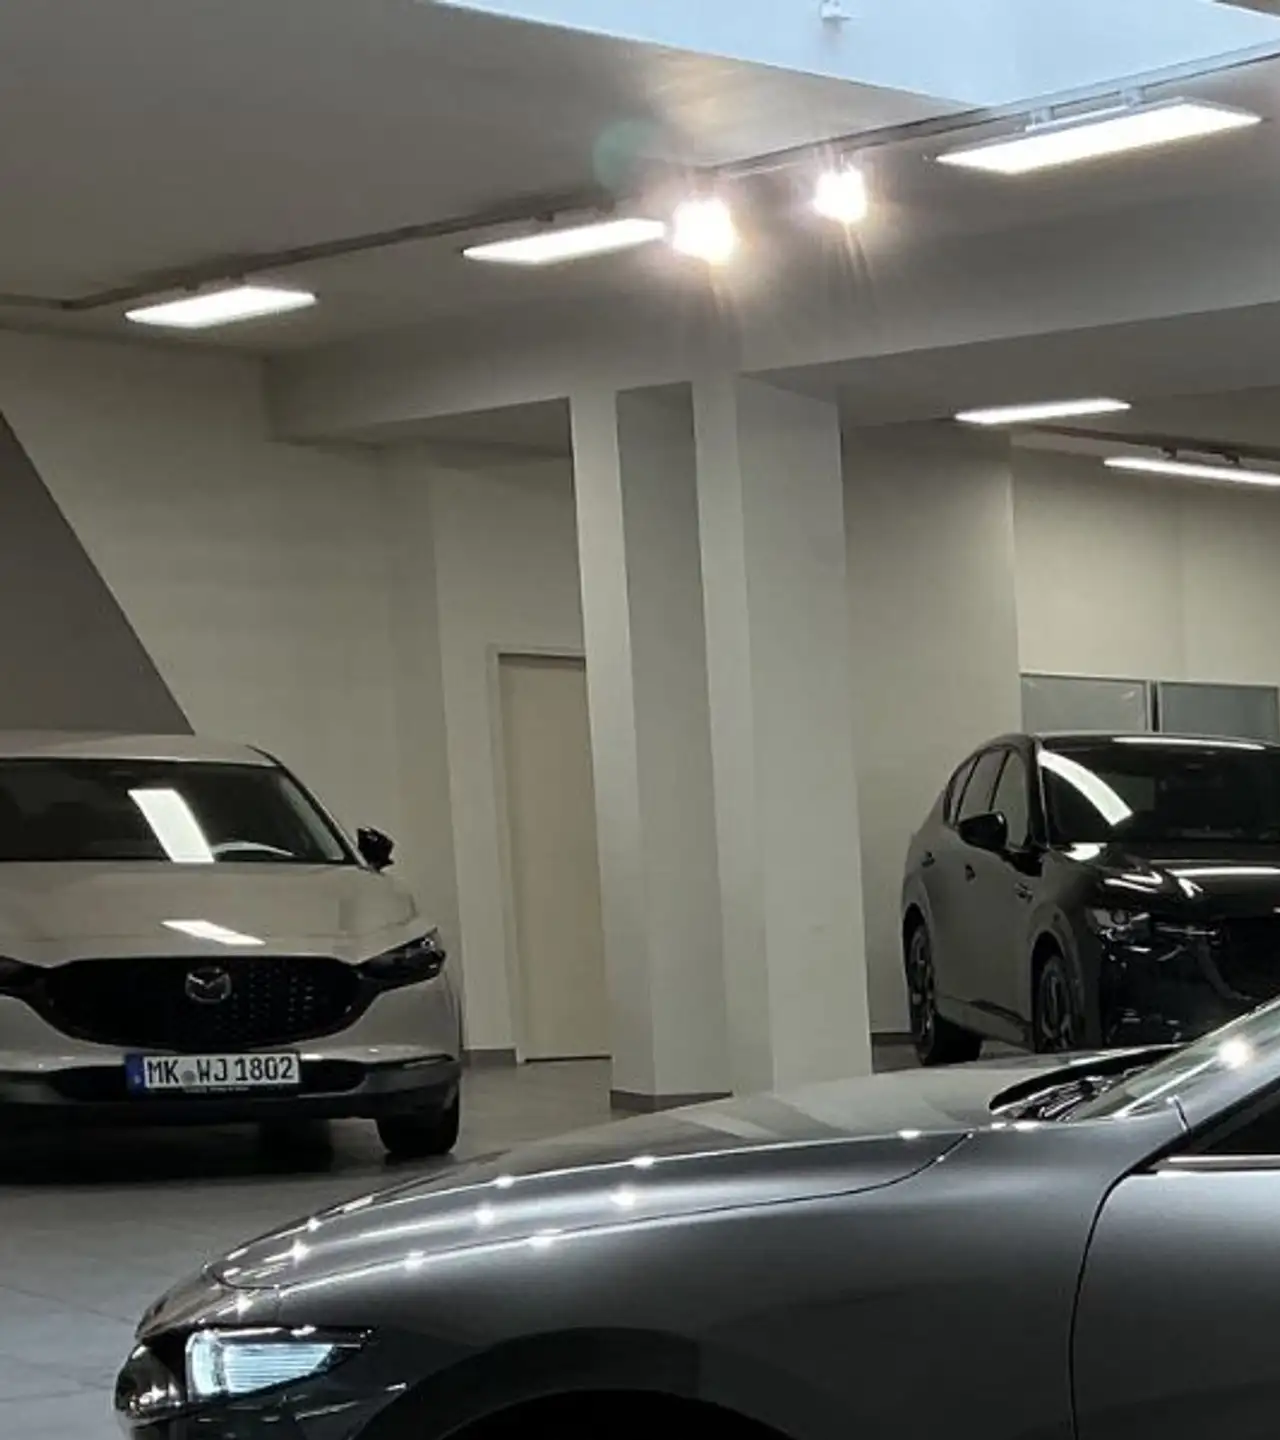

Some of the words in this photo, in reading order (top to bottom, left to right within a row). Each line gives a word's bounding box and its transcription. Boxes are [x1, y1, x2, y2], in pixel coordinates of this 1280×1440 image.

[148, 1059, 179, 1084] MK
[196, 1058, 228, 1082] WJ
[234, 1056, 294, 1082] 1802
